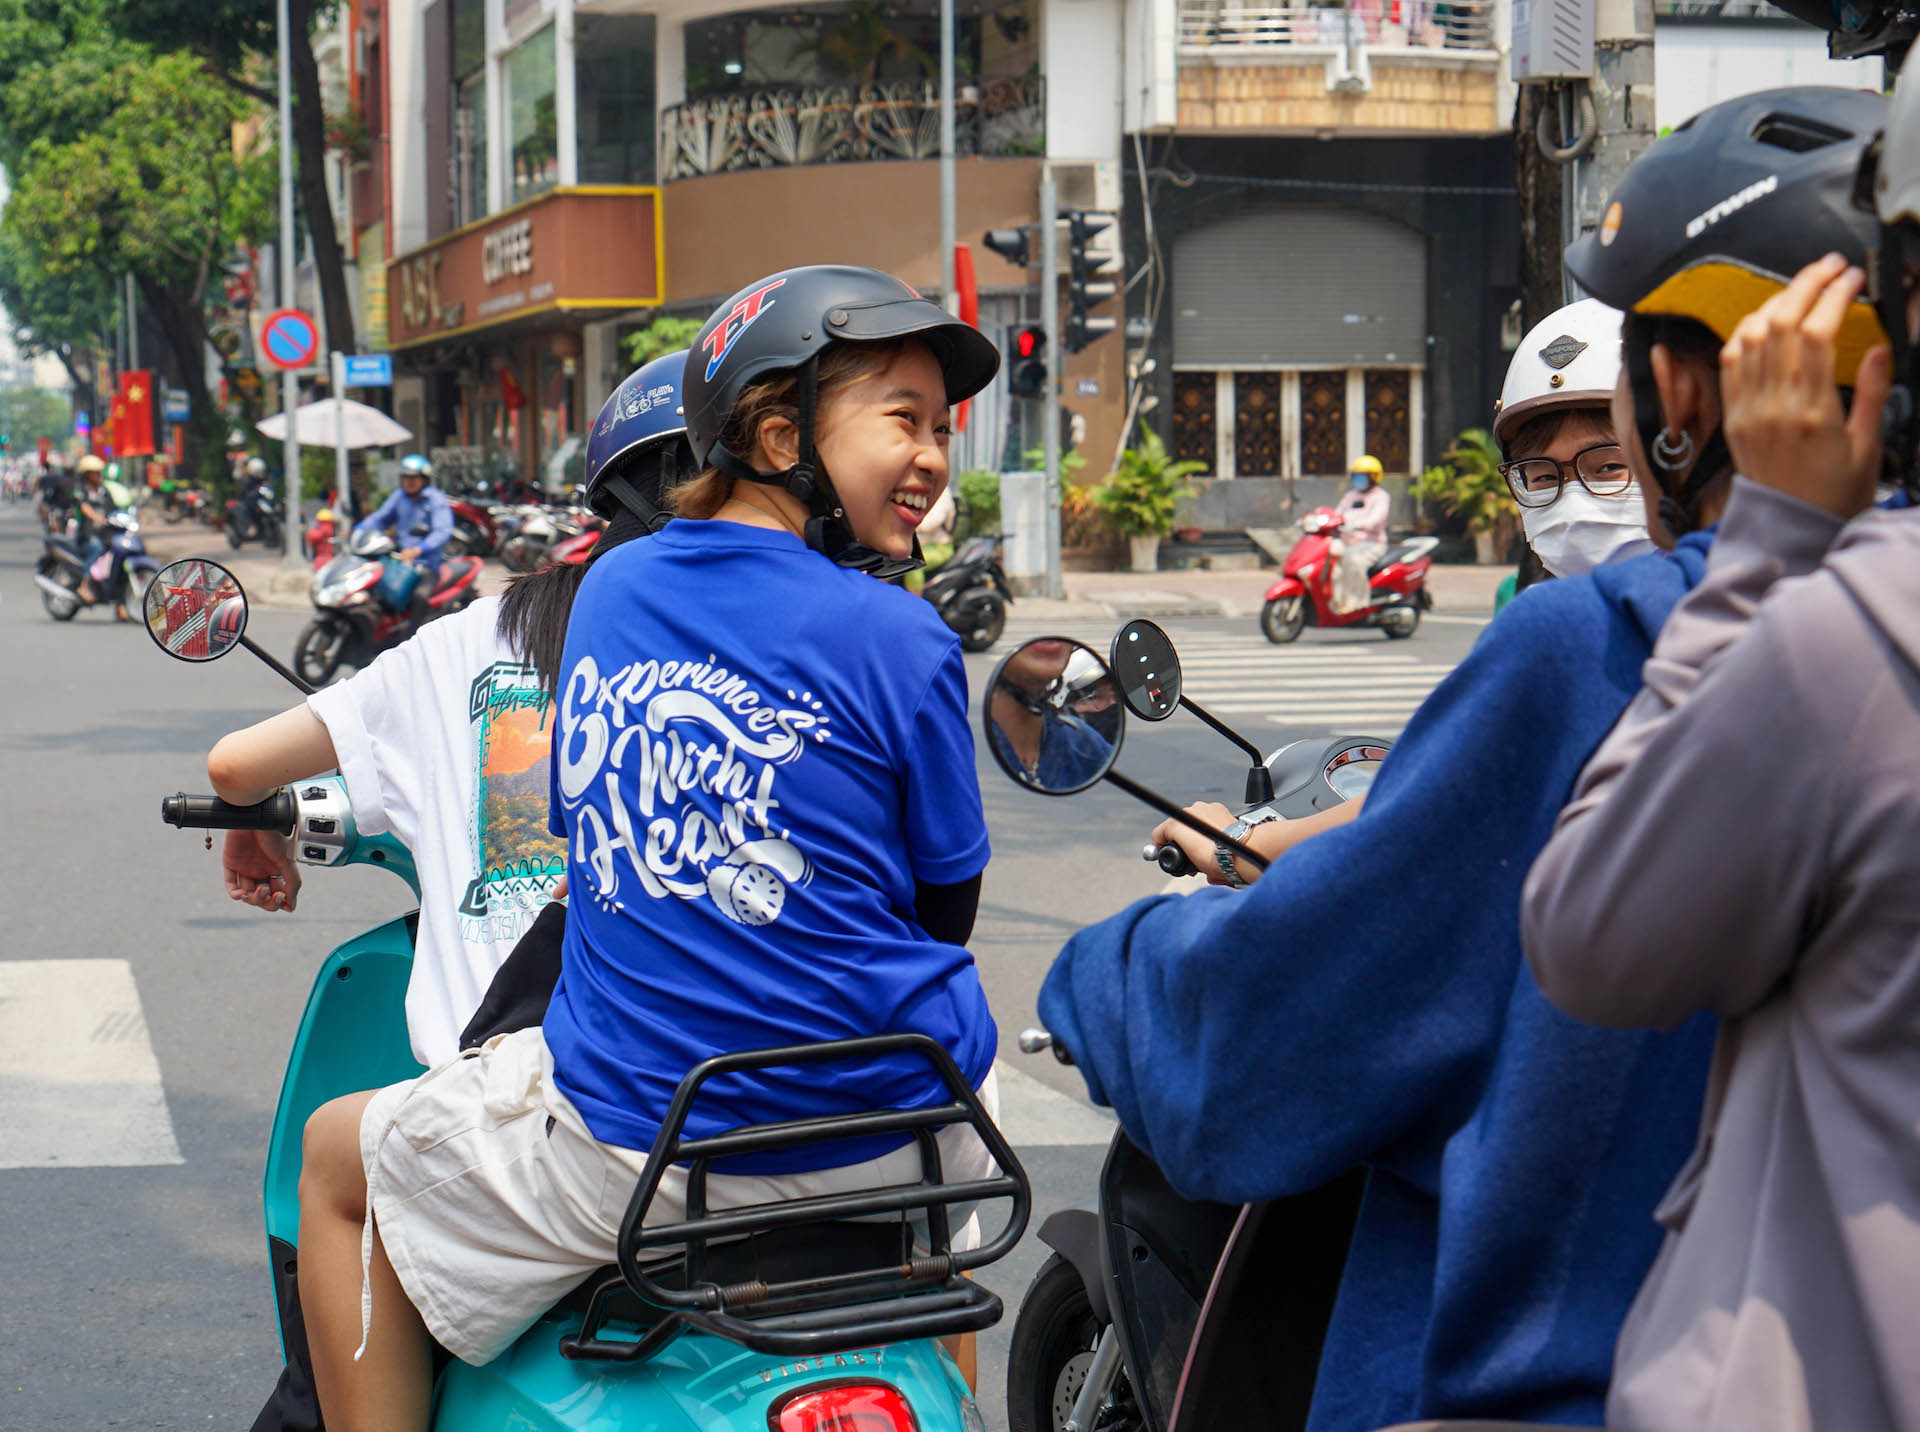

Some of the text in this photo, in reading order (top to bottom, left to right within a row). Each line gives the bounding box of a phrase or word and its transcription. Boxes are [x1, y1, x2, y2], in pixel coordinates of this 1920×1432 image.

[482, 218, 531, 285] COFFEE
[561, 654, 817, 799] Experiences
[610, 723, 754, 817] With
[575, 763, 781, 899] Heart
[757, 1351, 884, 1382] VINFAST
